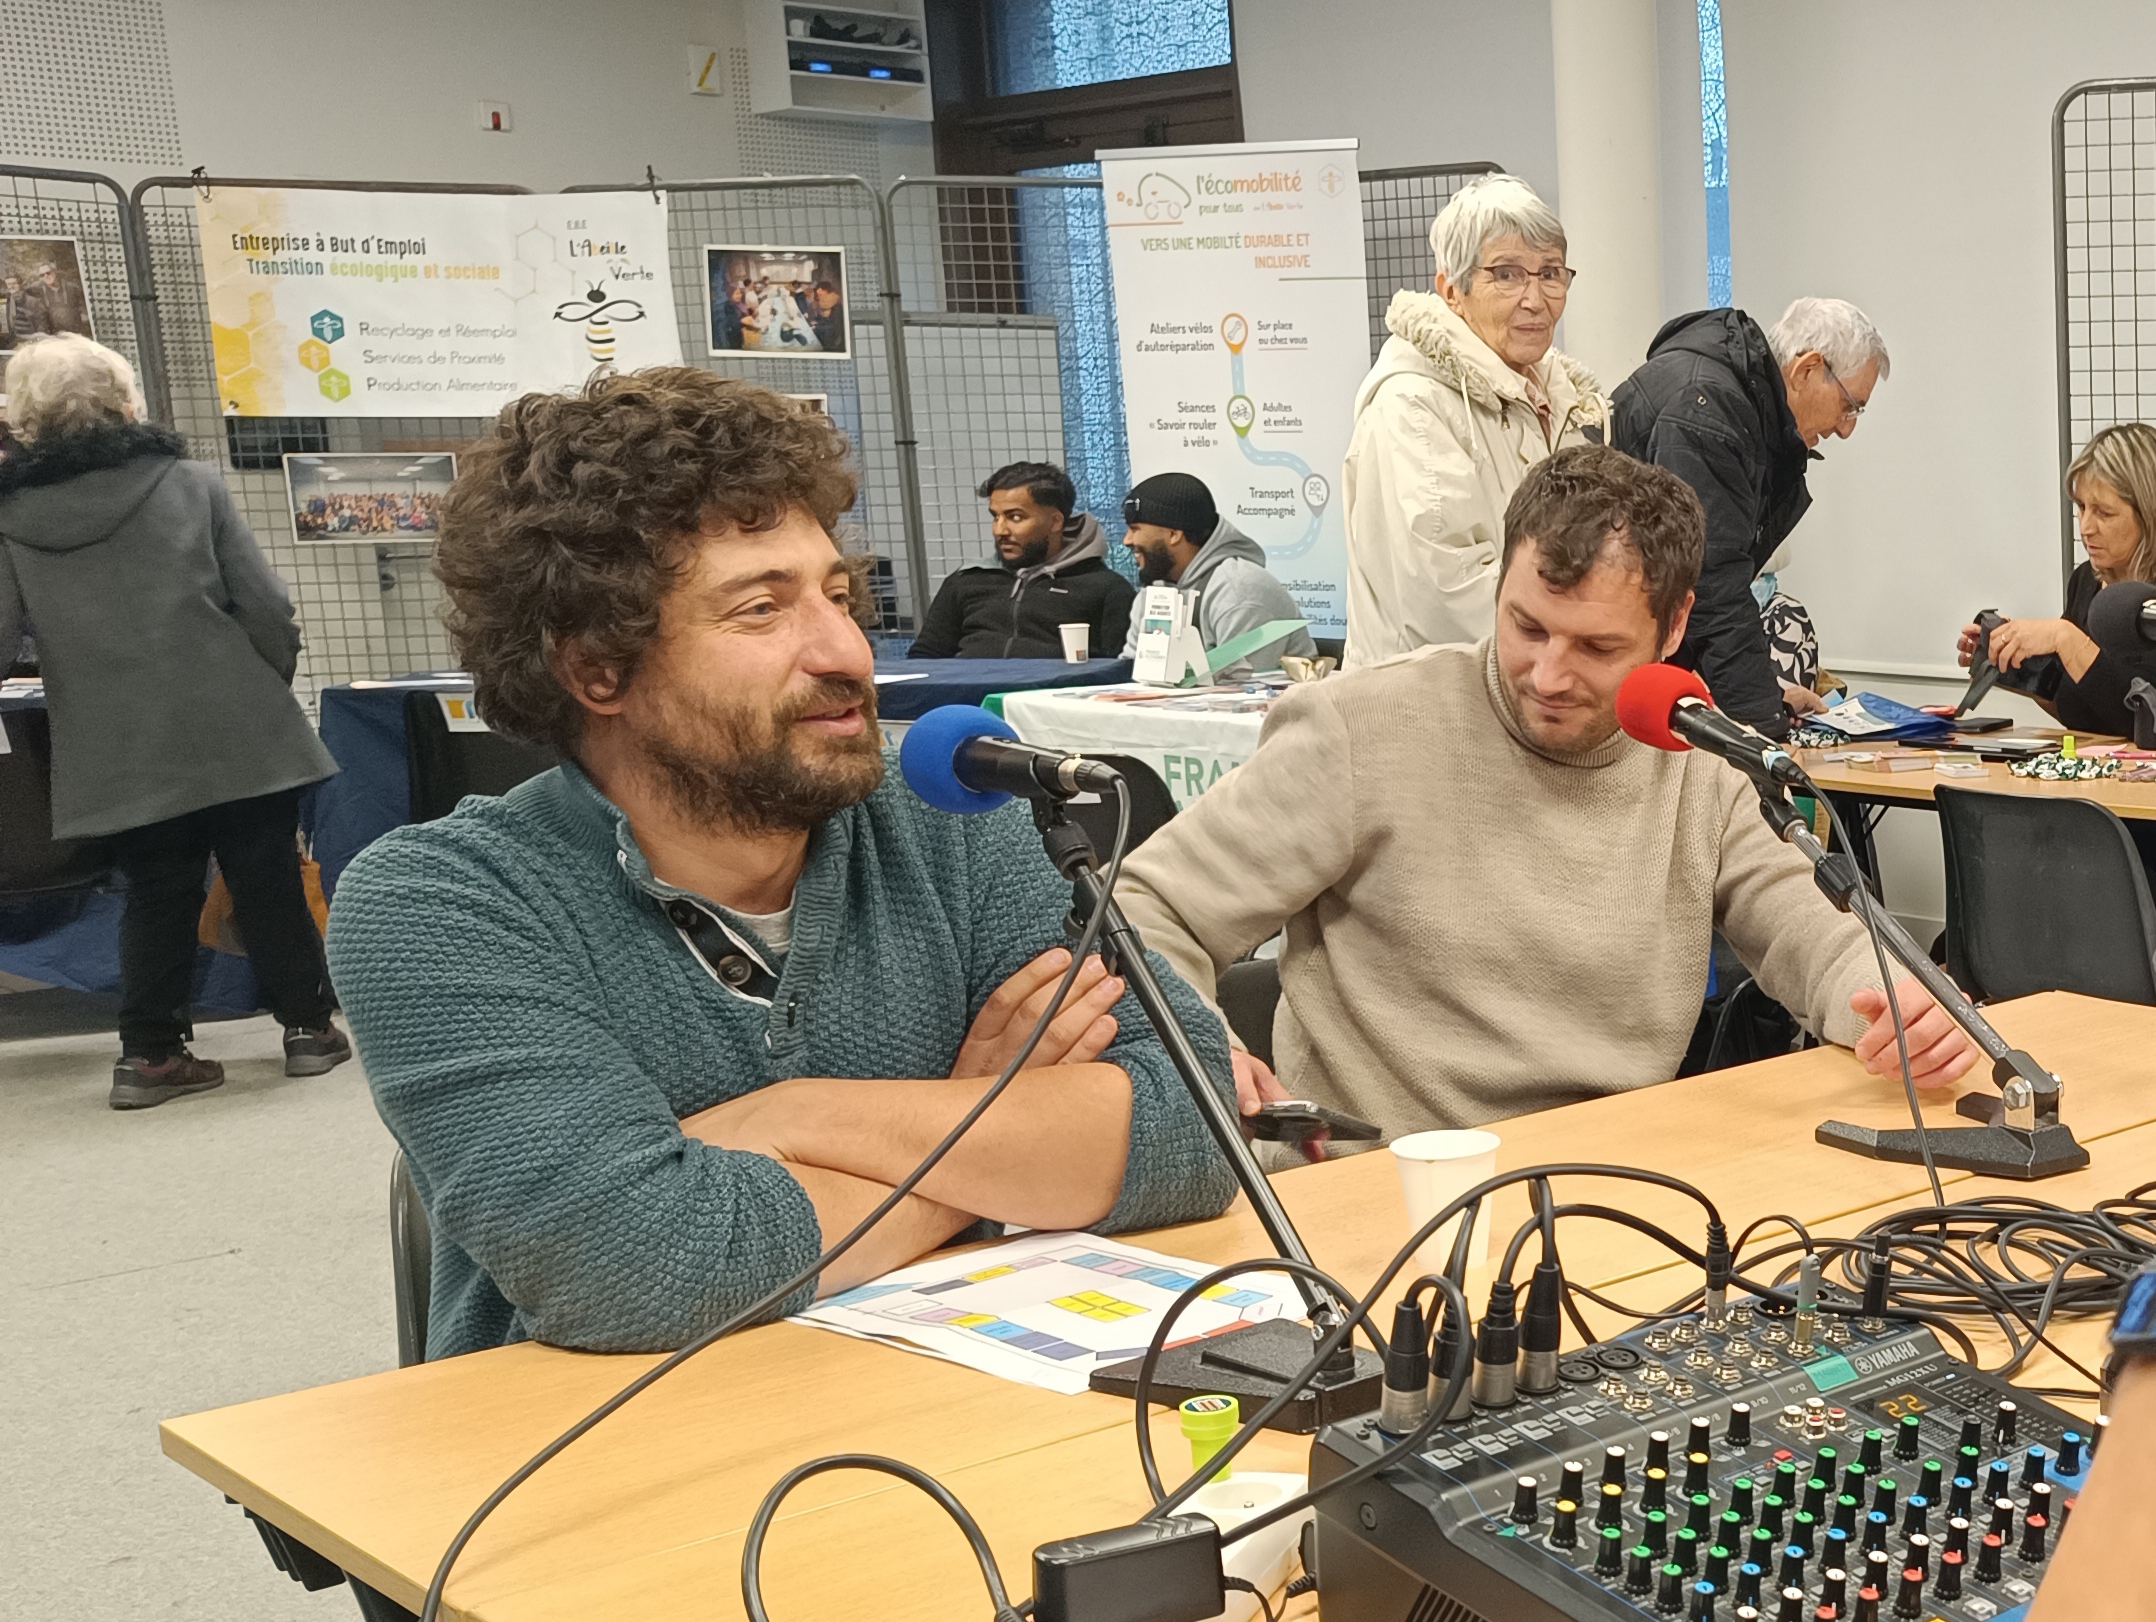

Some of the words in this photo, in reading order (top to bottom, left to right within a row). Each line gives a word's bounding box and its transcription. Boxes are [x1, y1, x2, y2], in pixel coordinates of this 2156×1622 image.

[1196, 170, 1303, 195] l'écomobilité
[1199, 204, 1220, 216] pour
[1222, 202, 1244, 213] tous
[231, 233, 310, 255] Entreprise
[316, 231, 325, 252] à
[330, 236, 357, 253] But
[361, 235, 426, 260] d'Emploi
[1141, 237, 1169, 251] VERS
[1171, 237, 1194, 250] UNE
[1244, 233, 1293, 248] DURABLE
[1296, 233, 1310, 247] ET
[1255, 254, 1311, 269] INCLUSIVE
[246, 257, 325, 275] Transition
[330, 257, 418, 283] écologique
[423, 263, 440, 279] et
[444, 262, 500, 280] sociale
[609, 265, 654, 281] Verte
[359, 322, 435, 340] Recyclage
[438, 325, 451, 338] et
[455, 323, 517, 340] Réemploi
[1150, 322, 1187, 335] Ateliers
[1188, 321, 1214, 334] vélos
[1257, 320, 1272, 331] Sur
[1273, 320, 1293, 332] place
[1136, 339, 1215, 354] d'autoréparation
[1258, 337, 1269, 345] ou
[1270, 335, 1288, 345] chez
[1289, 336, 1308, 345] vous
[363, 349, 424, 365] Services
[427, 350, 447, 365] de
[450, 350, 505, 365] Proximité
[366, 376, 442, 392] Production
[446, 377, 518, 392] Alimentaire
[1177, 401, 1216, 413] Séances
[1262, 402, 1293, 412] Adultes
[1157, 418, 1187, 431] Savoir
[1188, 418, 1217, 430] rouler
[1263, 418, 1272, 426] et
[1273, 416, 1303, 427] enfants
[1183, 436, 1189, 447] à
[1191, 436, 1211, 447] vélo
[1248, 486, 1295, 501] Transport
[1236, 504, 1296, 519] Accompagné
[1280, 579, 1336, 591] nsibilisation
[1295, 597, 1331, 609] lutions
[1329, 614, 1347, 626] dou
[1164, 754, 1240, 797] FRA
[1868, 1341, 1920, 1370] YAMAHA
[1884, 1363, 1938, 1388] MG12XU
[1788, 1382, 1807, 1395] 11/12
[1879, 1394, 1928, 1418] 22
